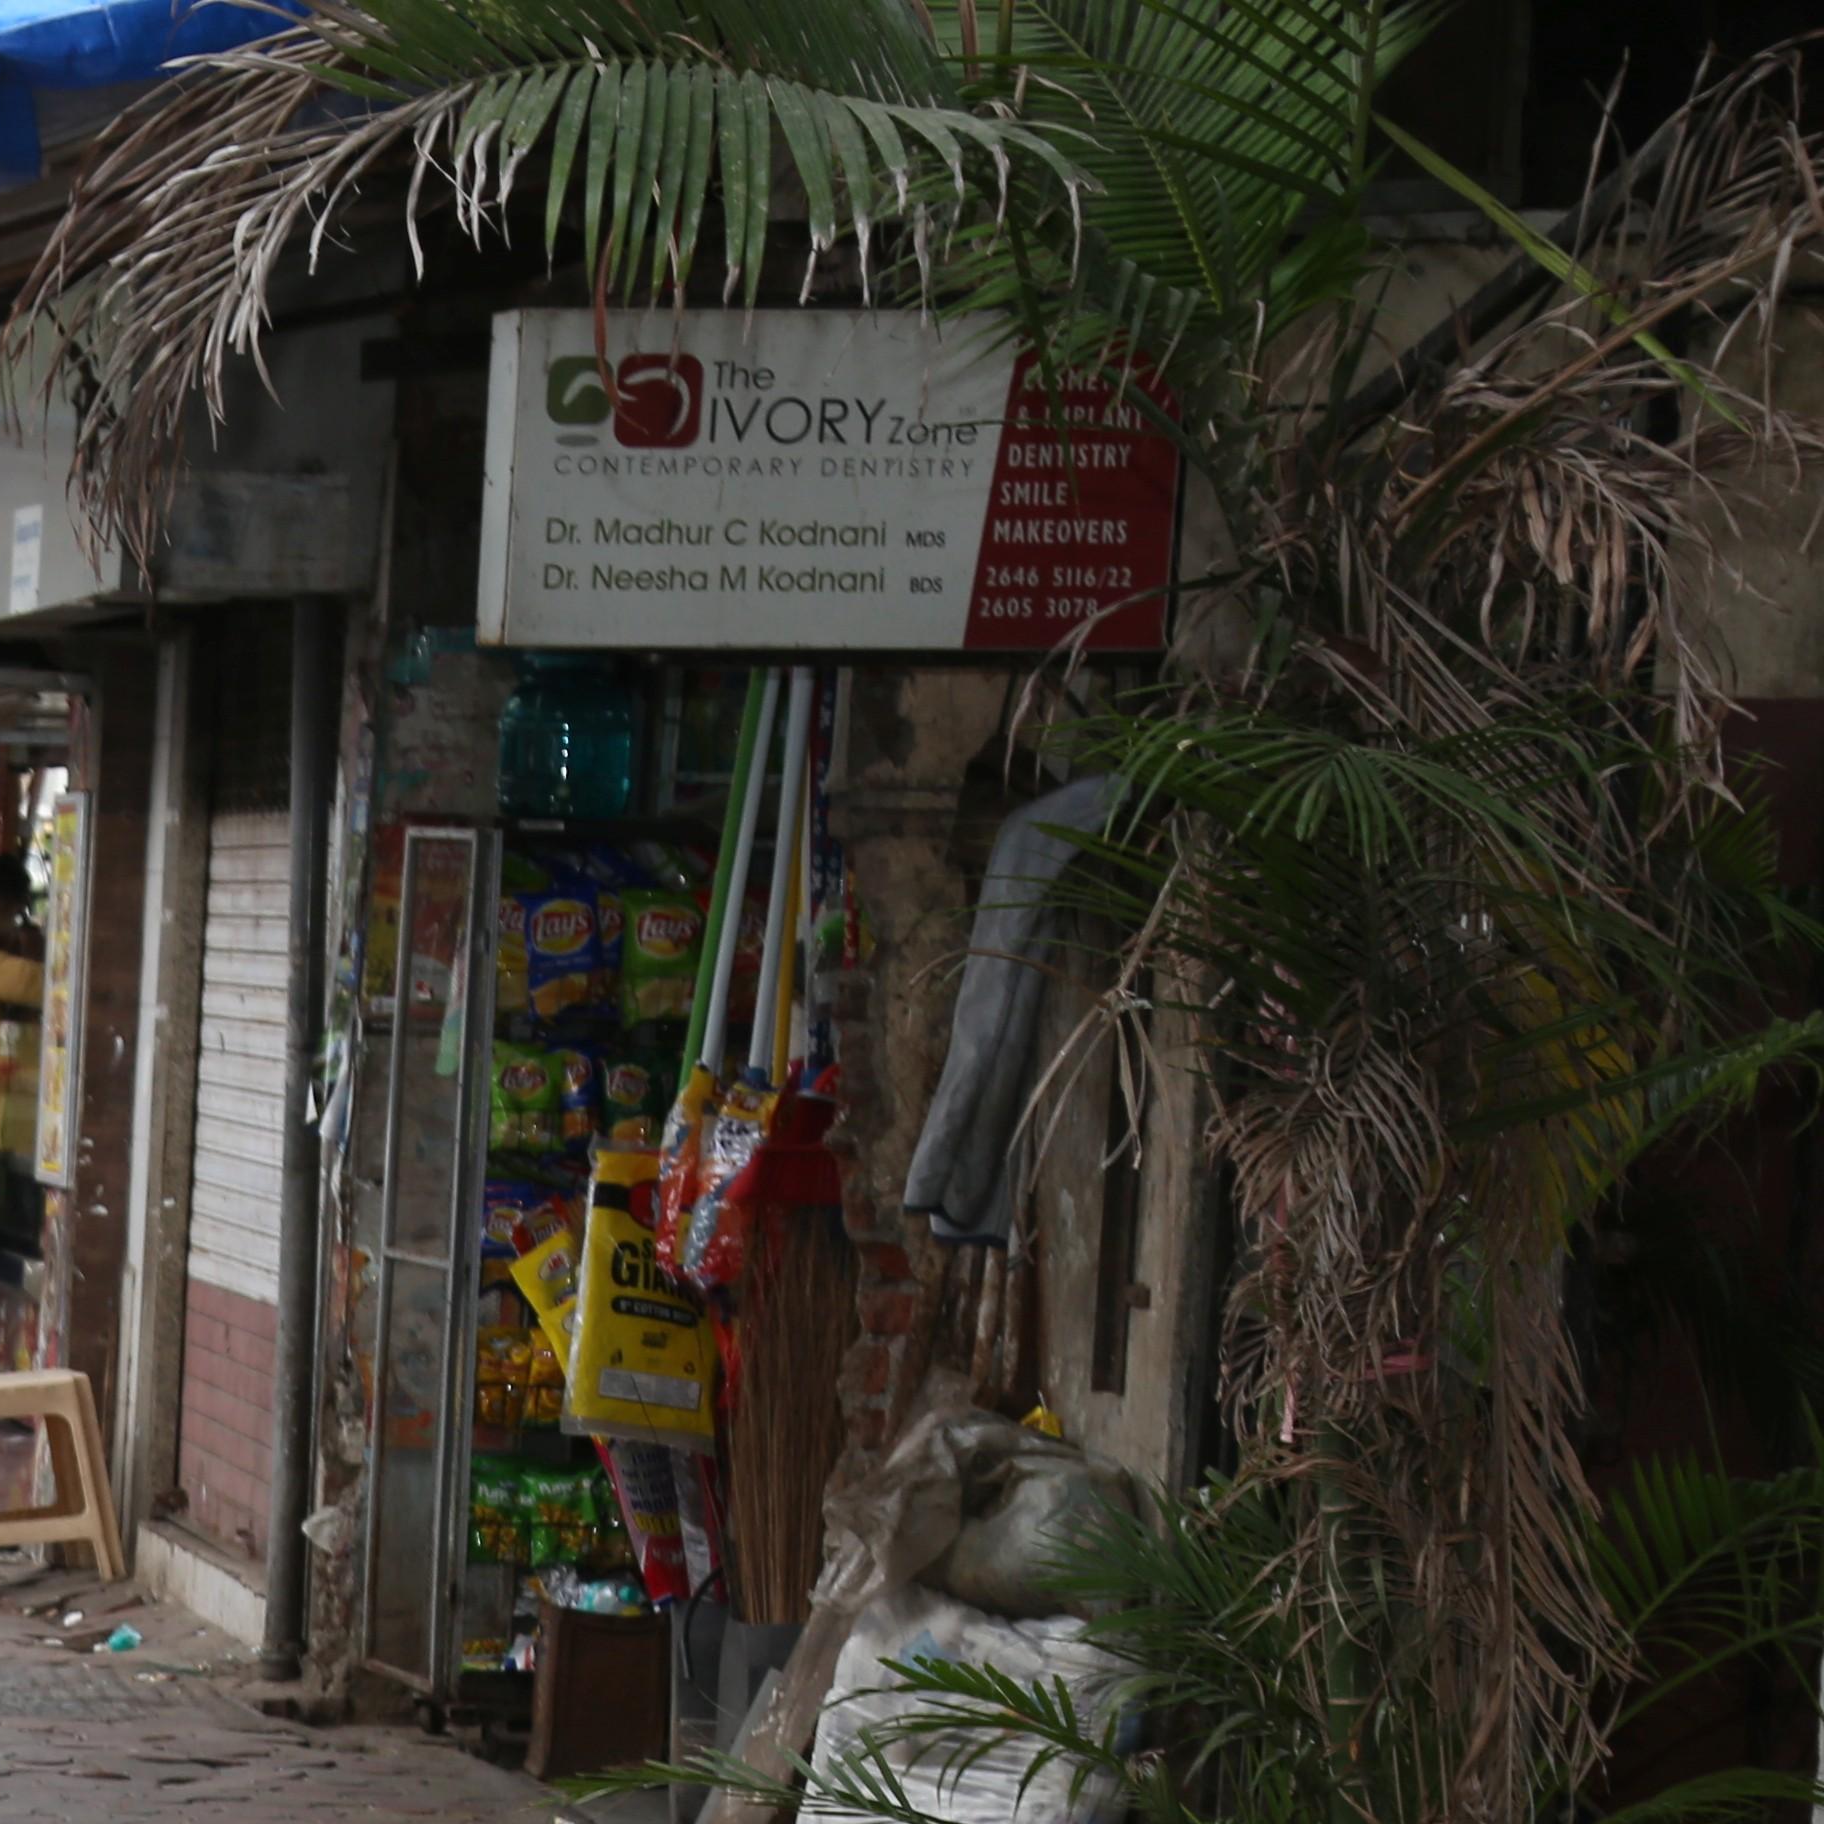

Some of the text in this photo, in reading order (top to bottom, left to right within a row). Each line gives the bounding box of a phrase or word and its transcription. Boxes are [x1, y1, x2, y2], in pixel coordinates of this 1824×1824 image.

[714, 361, 775, 391] The
[709, 397, 978, 446] IVORY Zone
[553, 456, 972, 478] CONTEMPORARY DENTISTRY
[1008, 442, 1132, 469] DENTISTRY
[1000, 482, 1070, 506] SMILE
[545, 518, 946, 548] Dr. Madhur C Kodnani MDS
[993, 519, 1129, 545] MAKEOVERS
[543, 563, 943, 594] Dr. Neesha M Kodnani BDS
[985, 566, 1133, 589] 2646 5116/22
[980, 596, 1098, 619] 2605 3078
